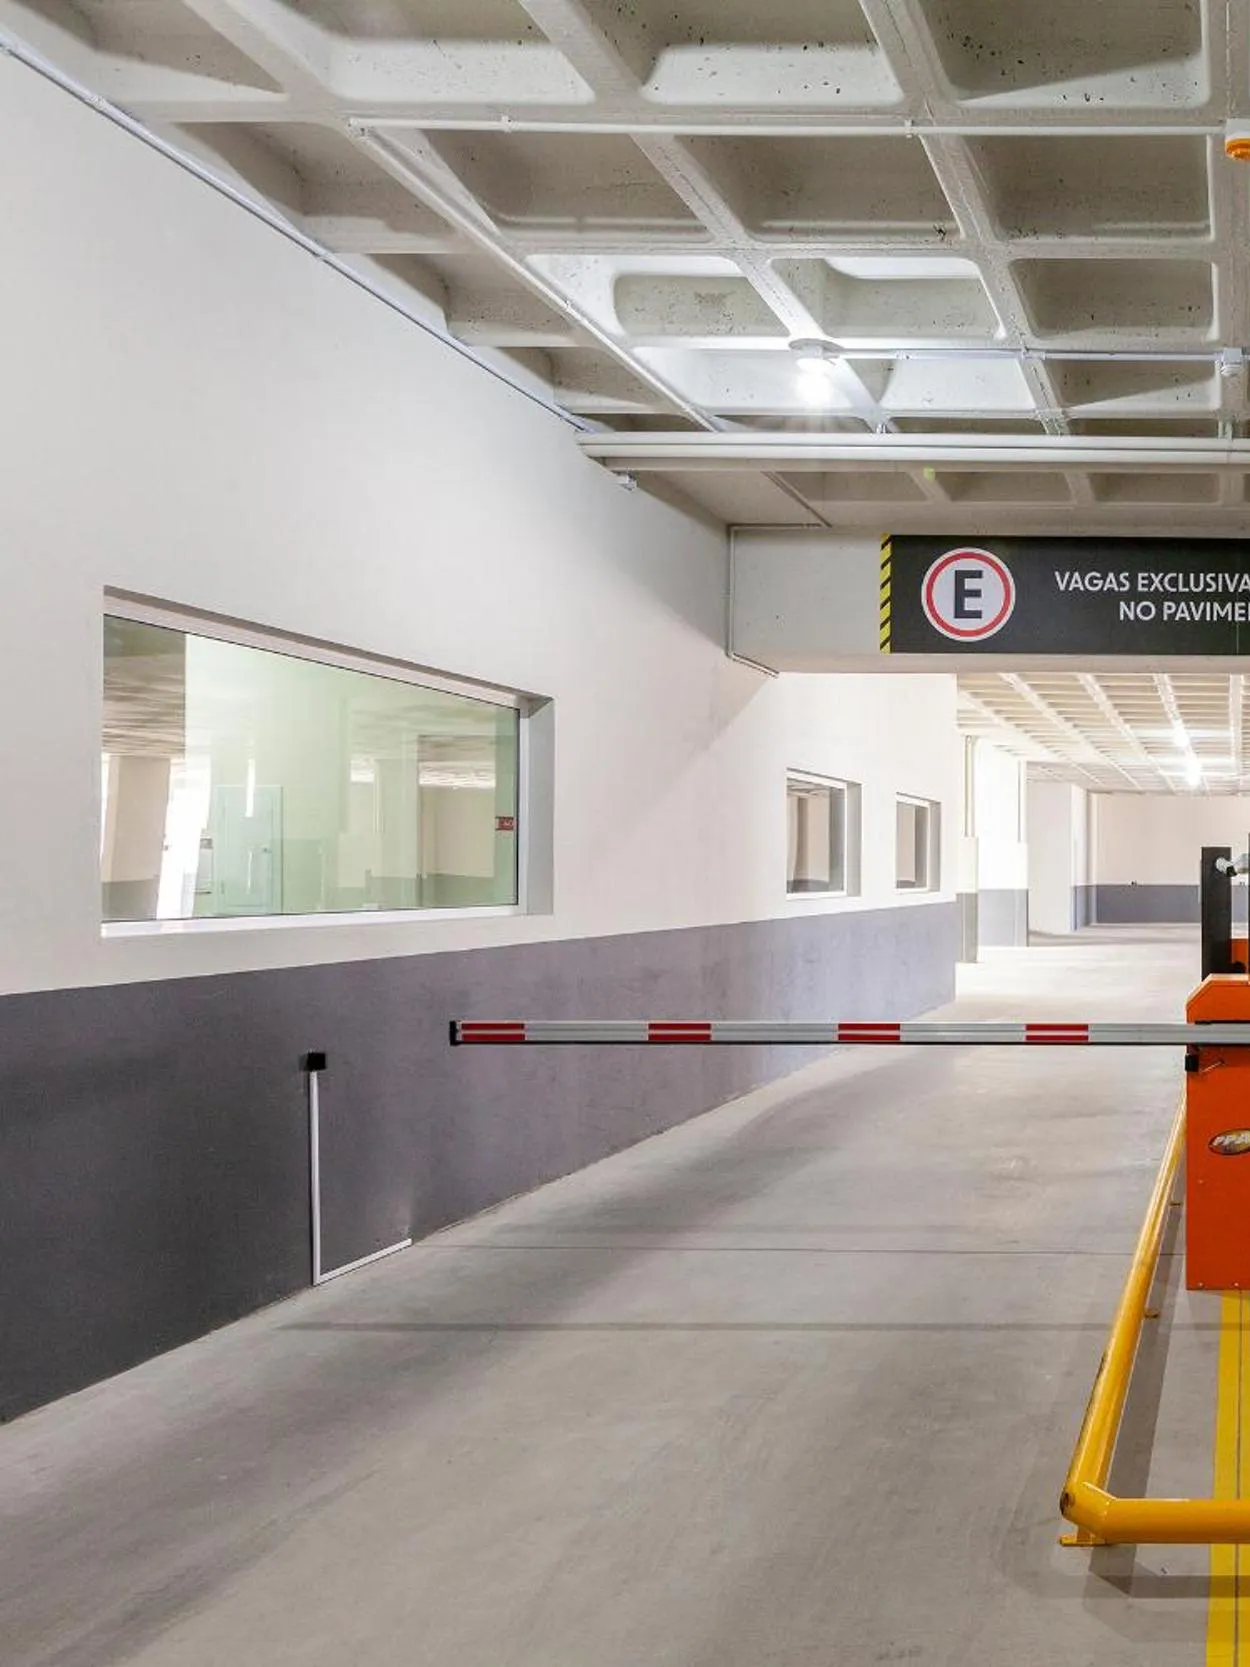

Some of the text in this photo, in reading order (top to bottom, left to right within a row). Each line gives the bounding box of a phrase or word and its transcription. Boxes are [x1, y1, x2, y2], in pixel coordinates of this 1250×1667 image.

[1054, 570, 1131, 593] VAGAS
[953, 569, 983, 619] E
[1119, 600, 1157, 622] NO
